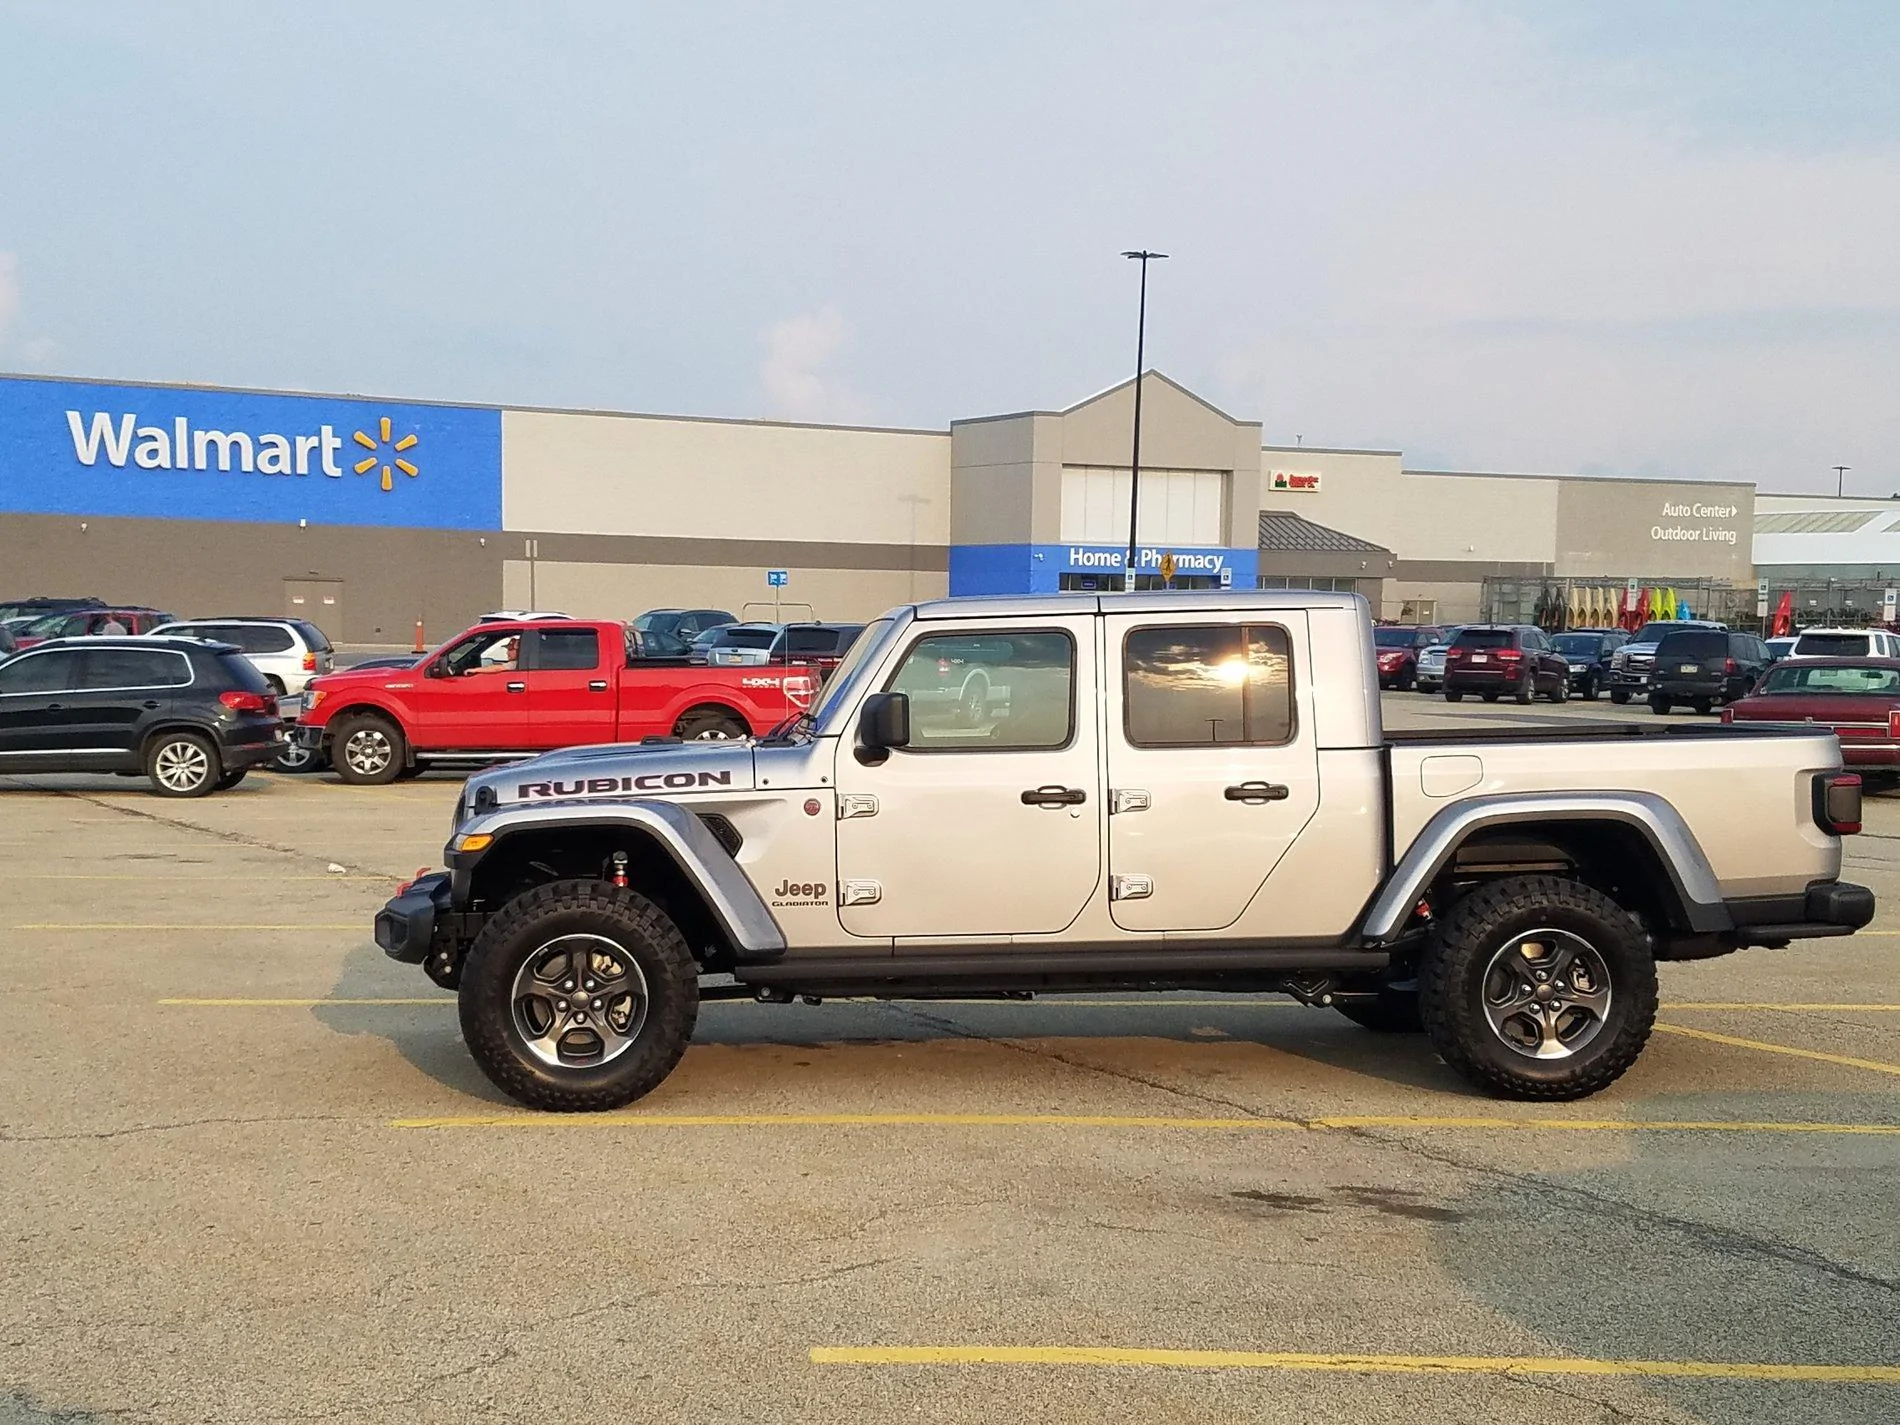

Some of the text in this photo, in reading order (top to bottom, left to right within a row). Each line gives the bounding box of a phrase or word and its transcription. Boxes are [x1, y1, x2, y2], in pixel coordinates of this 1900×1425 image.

[65, 410, 343, 477] Walmart
[1662, 502, 1731, 517] Auto Center
[1651, 526, 1737, 545] Outdoor Living
[1070, 548, 1120, 567] Home
[1141, 549, 1224, 574] Phrmacy
[518, 771, 731, 798] RUBICON
[774, 879, 827, 899] Jeep
